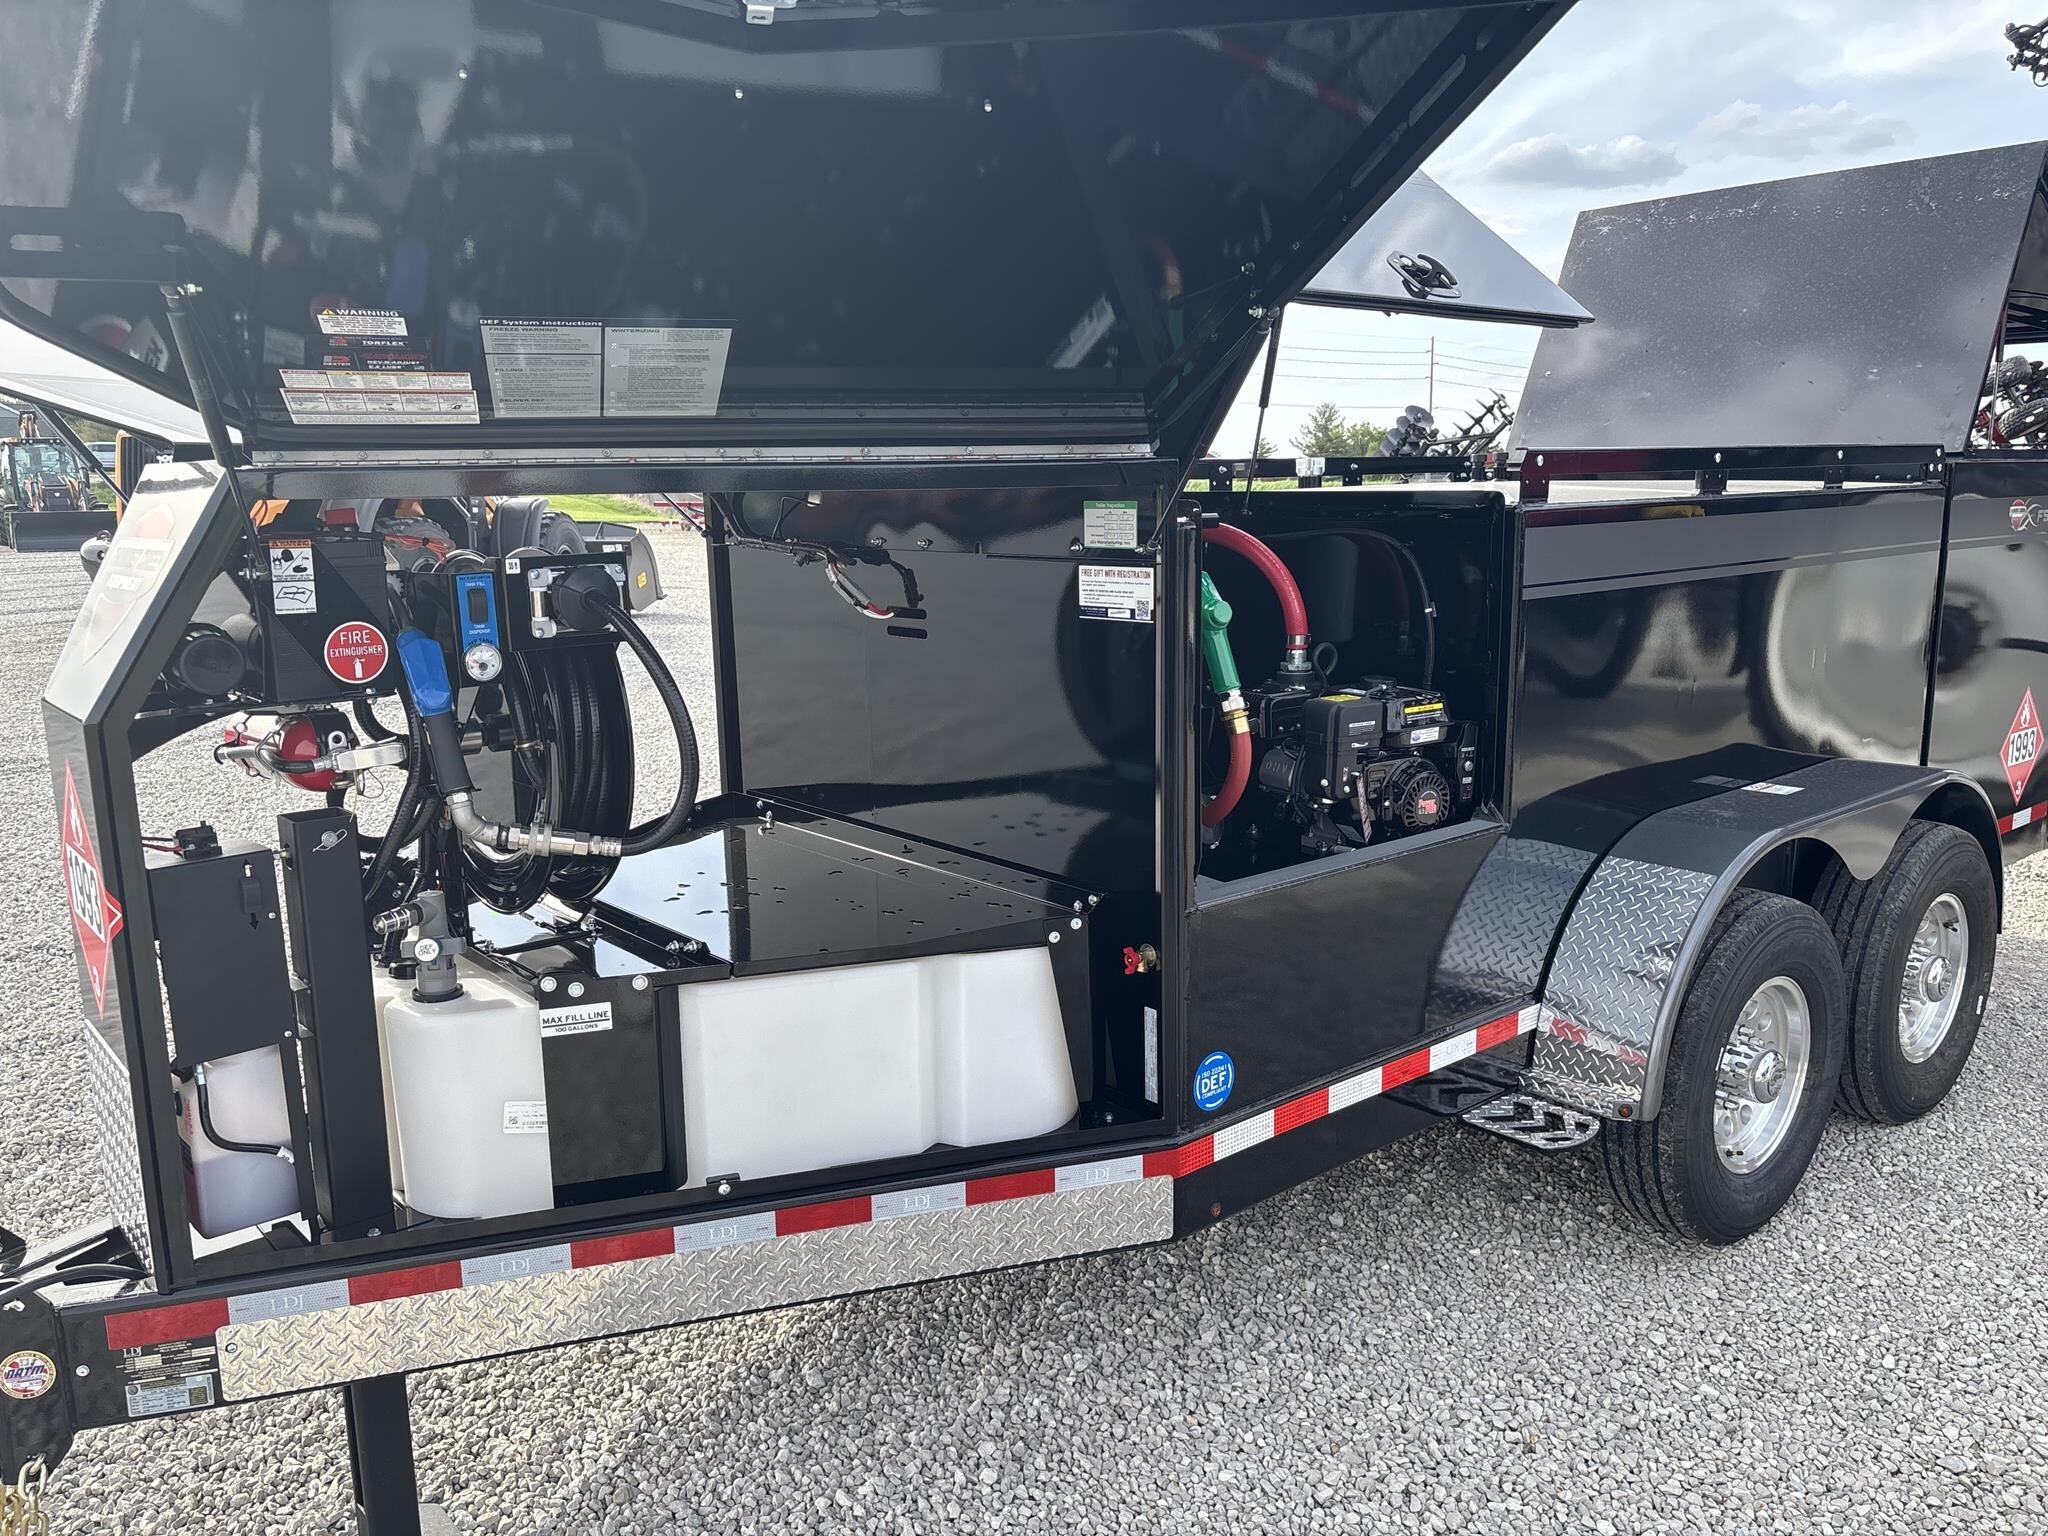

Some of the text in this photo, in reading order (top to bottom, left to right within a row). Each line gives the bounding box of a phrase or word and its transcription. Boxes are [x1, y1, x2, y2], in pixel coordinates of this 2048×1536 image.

[335, 309, 399, 317] WARNING
[1081, 568, 1151, 579] FREE GIFT WITH REGISTRATION
[340, 630, 371, 645] FIRE
[330, 644, 383, 658] EXTINGUISHER
[2010, 729, 2036, 764] 1993
[2016, 780, 2022, 796] 3
[69, 849, 101, 934] 1993
[418, 948, 436, 956] ONLY
[92, 966, 101, 998] 3
[542, 1010, 610, 1025] MAX FILL LINE
[568, 1023, 599, 1032] GALLONS
[1201, 1070, 1211, 1079] ISO
[1201, 1071, 1227, 1094] DEF
[1201, 1085, 1227, 1100] COMPLIANT
[1085, 1168, 1111, 1182] LDJ
[904, 1194, 931, 1209] LDJ
[709, 1225, 738, 1240] LDJ
[500, 1258, 531, 1273] LDJ
[270, 1295, 303, 1311] LDJ
[123, 1346, 142, 1358] LDJ
